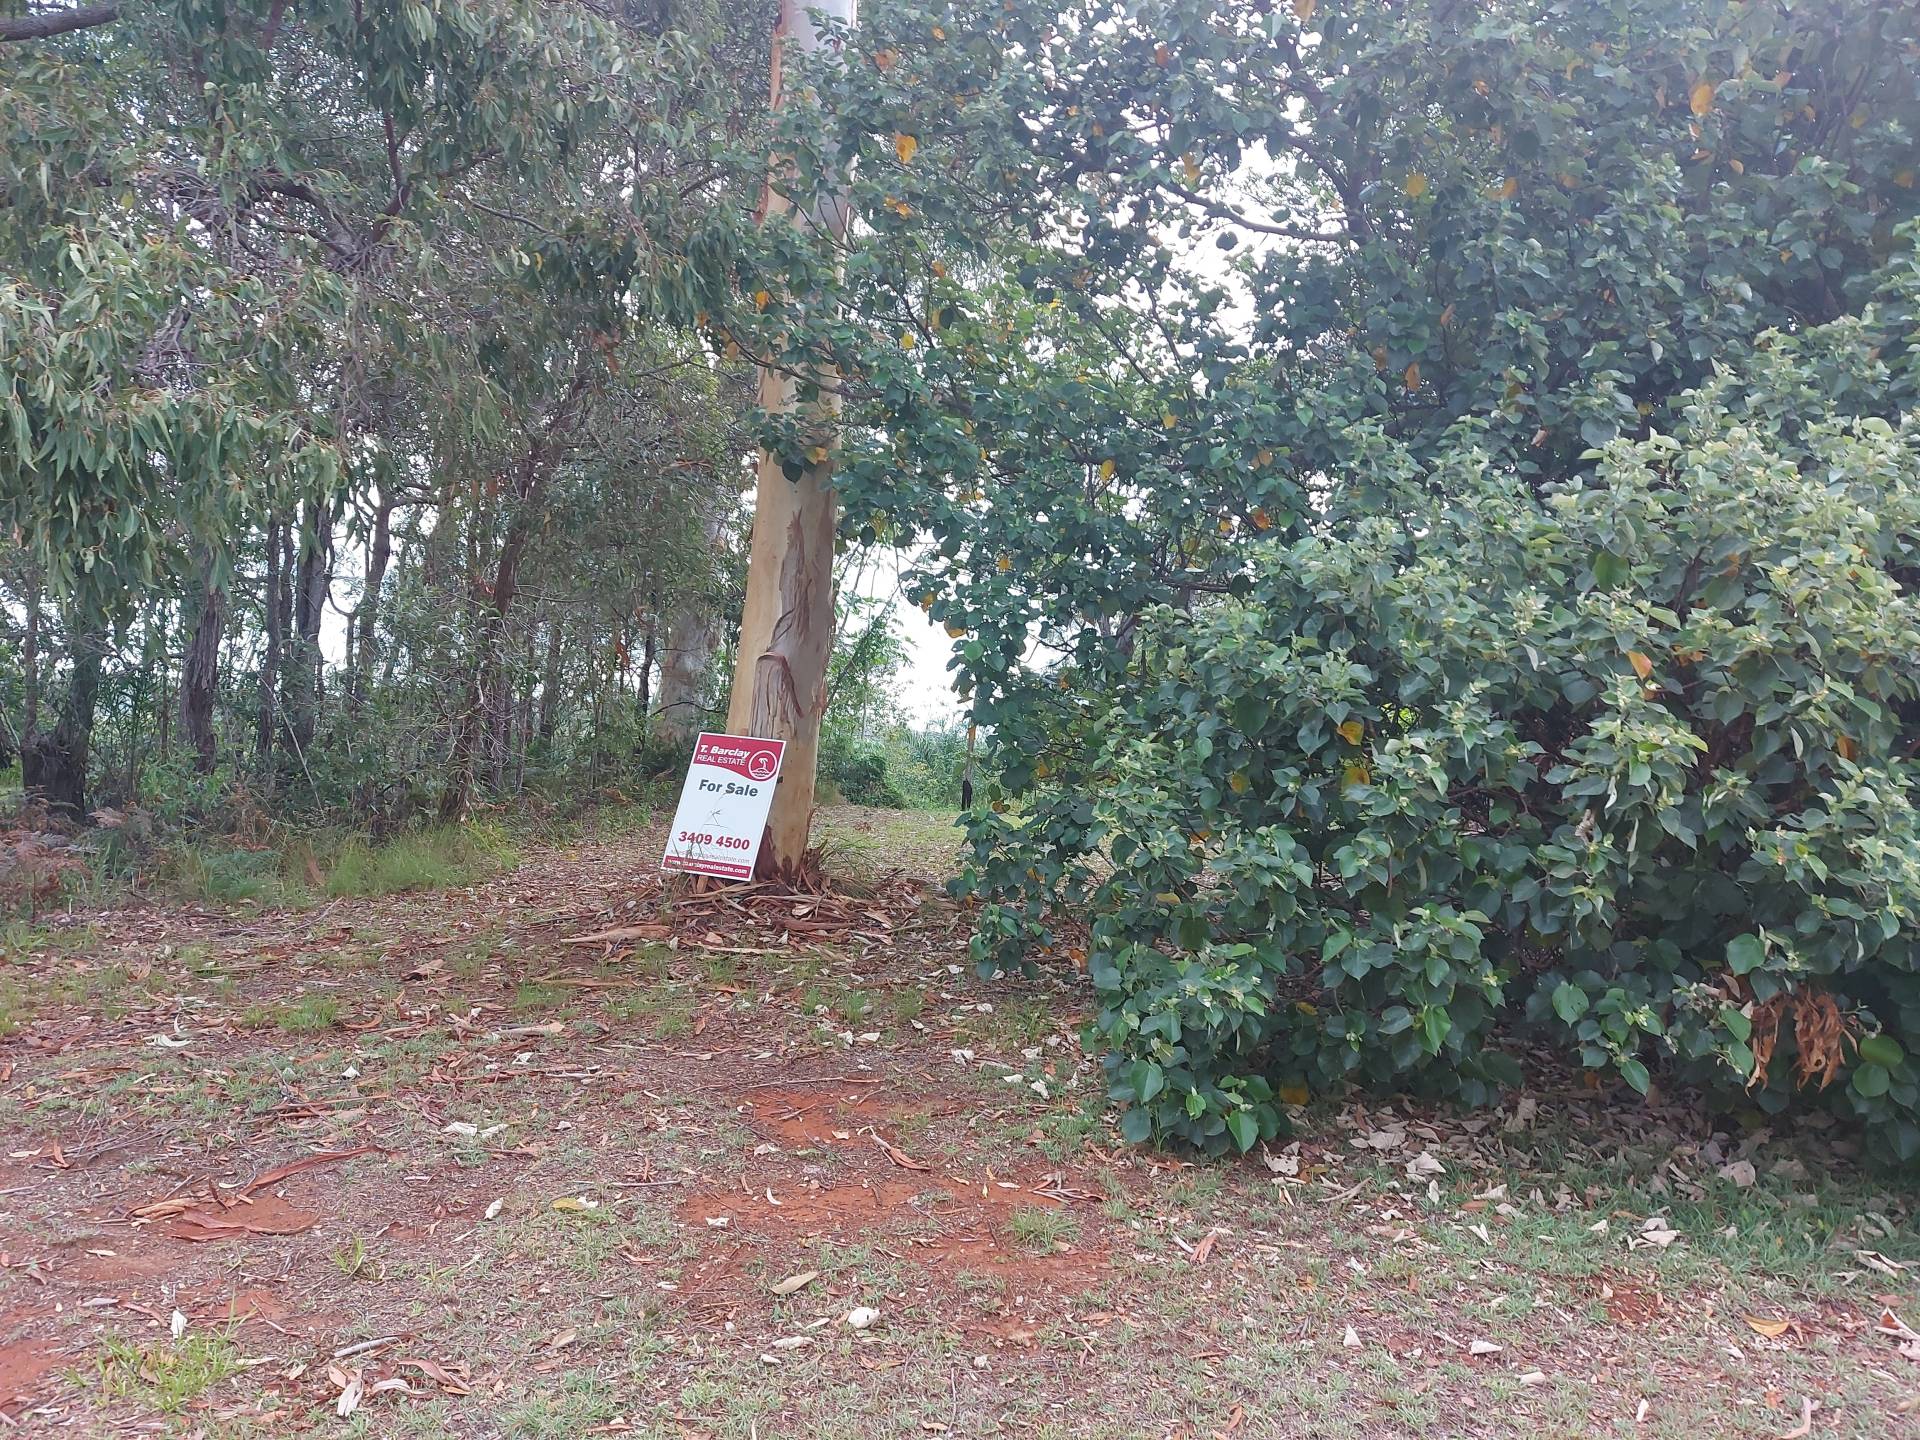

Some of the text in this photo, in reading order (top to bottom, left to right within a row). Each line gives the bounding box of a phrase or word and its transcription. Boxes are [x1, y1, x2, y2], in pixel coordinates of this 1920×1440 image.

[700, 745, 750, 758] T. Barclay
[718, 757, 746, 766] ESTATE
[699, 780, 758, 796] For Sale
[679, 831, 750, 850] 3409 4500
